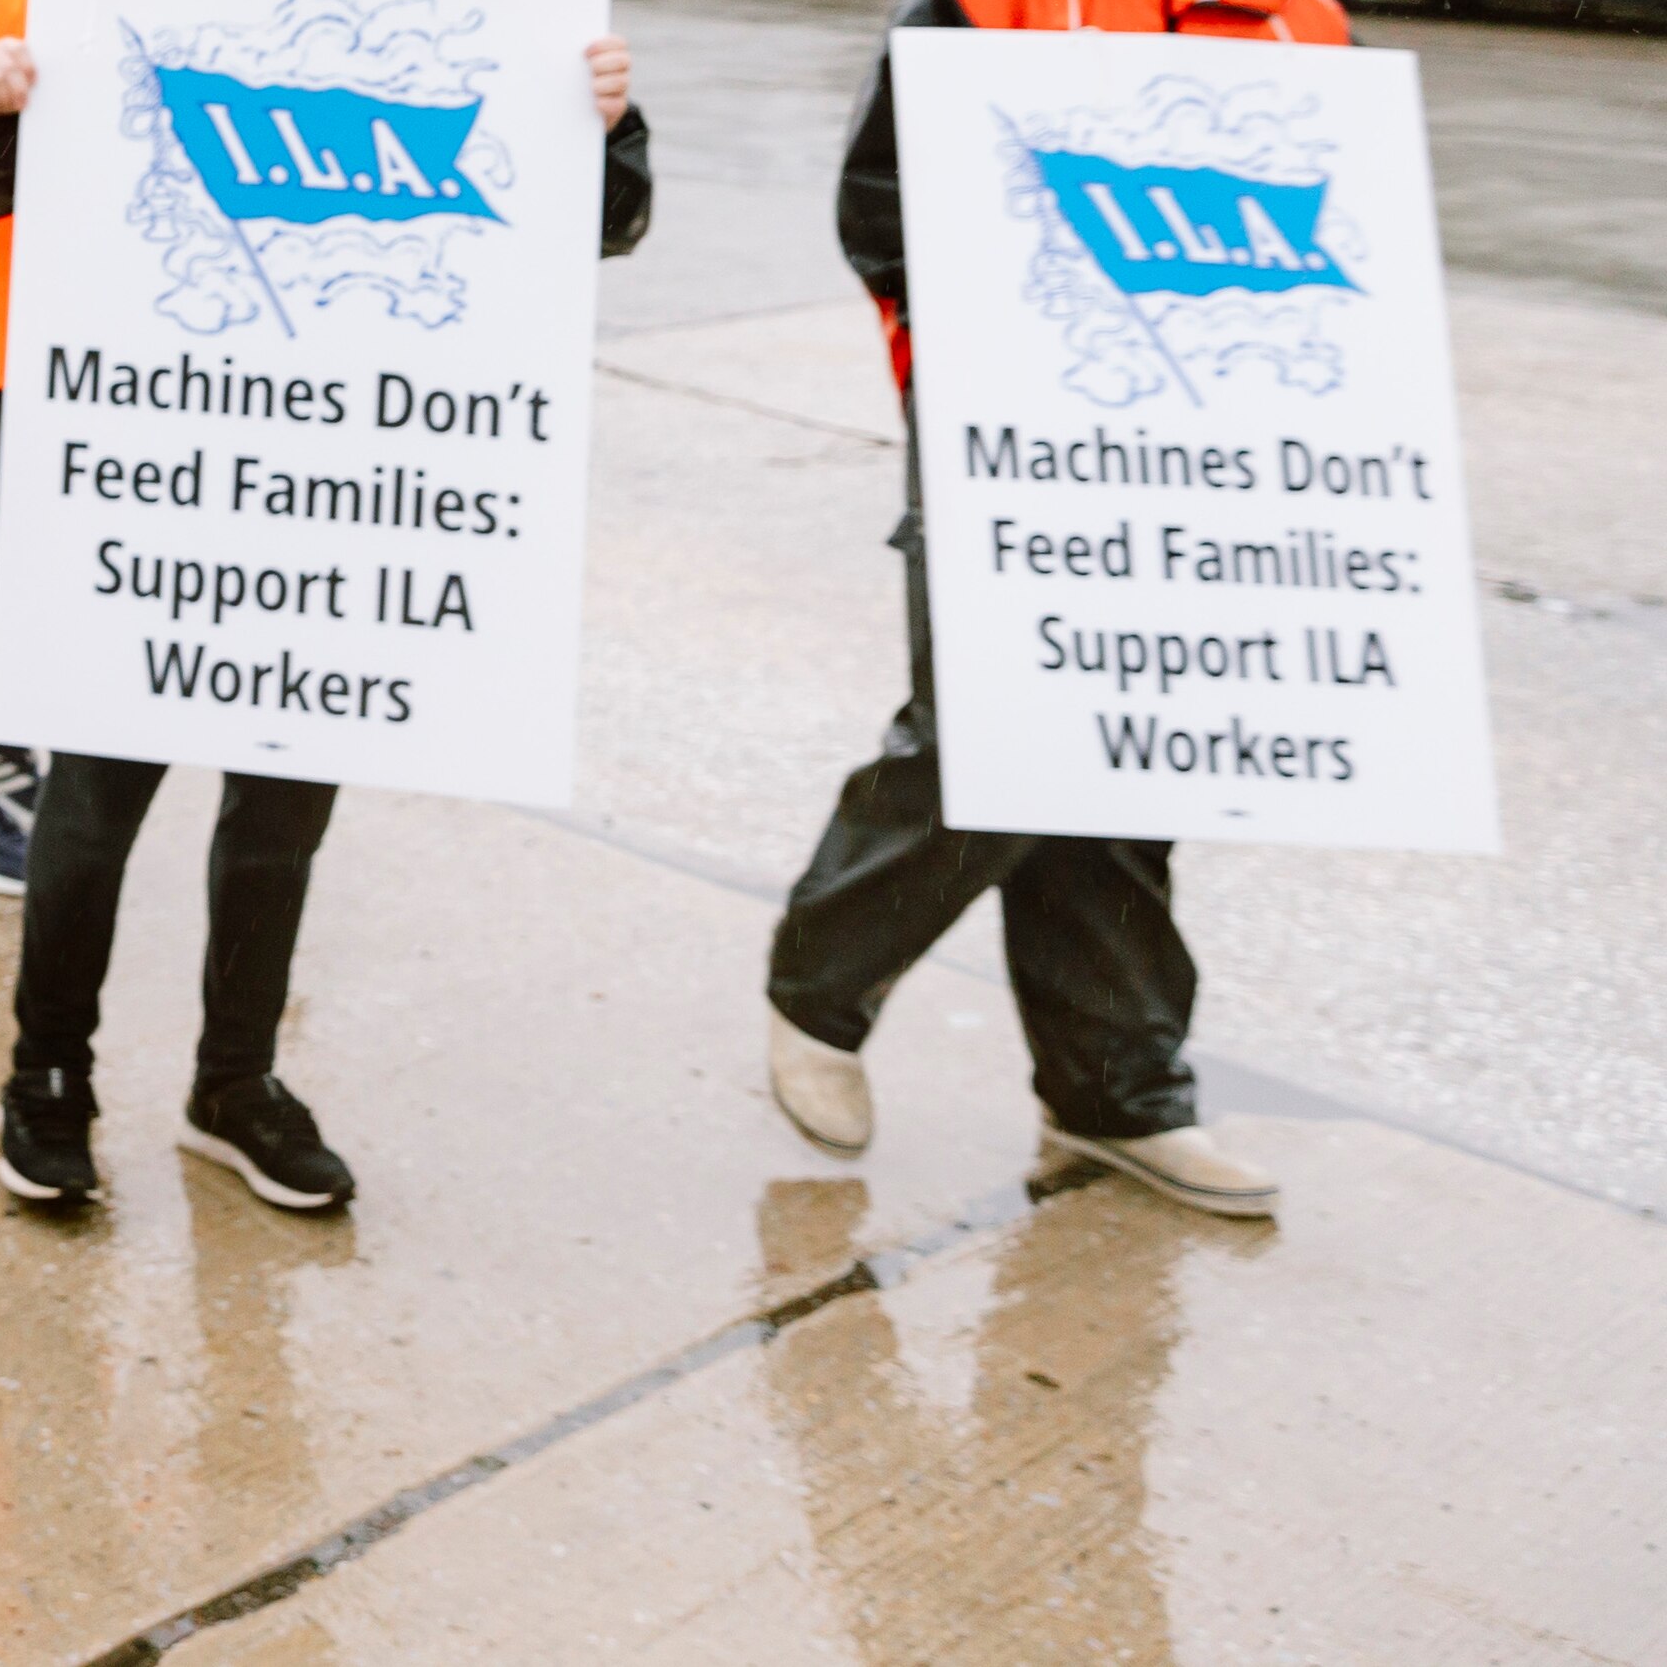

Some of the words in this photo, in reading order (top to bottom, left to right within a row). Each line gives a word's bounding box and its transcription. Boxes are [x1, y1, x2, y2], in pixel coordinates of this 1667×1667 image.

[202, 102, 462, 199] I.L.A.
[1081, 183, 1327, 271] I.L.A.
[47, 346, 346, 424] Machines
[376, 372, 549, 442] Don't
[62, 441, 203, 507] Feed
[232, 456, 520, 538] Families:
[965, 424, 1256, 491] Machines
[1279, 438, 1431, 501] Don't
[95, 539, 346, 625] Support
[377, 567, 473, 632] ILA
[992, 519, 1133, 578] Feed
[1160, 525, 1420, 593] Families:
[144, 639, 411, 723] Workers
[1038, 615, 1282, 694] Support
[1306, 629, 1395, 686] ILA
[1097, 714, 1353, 781] Workers
